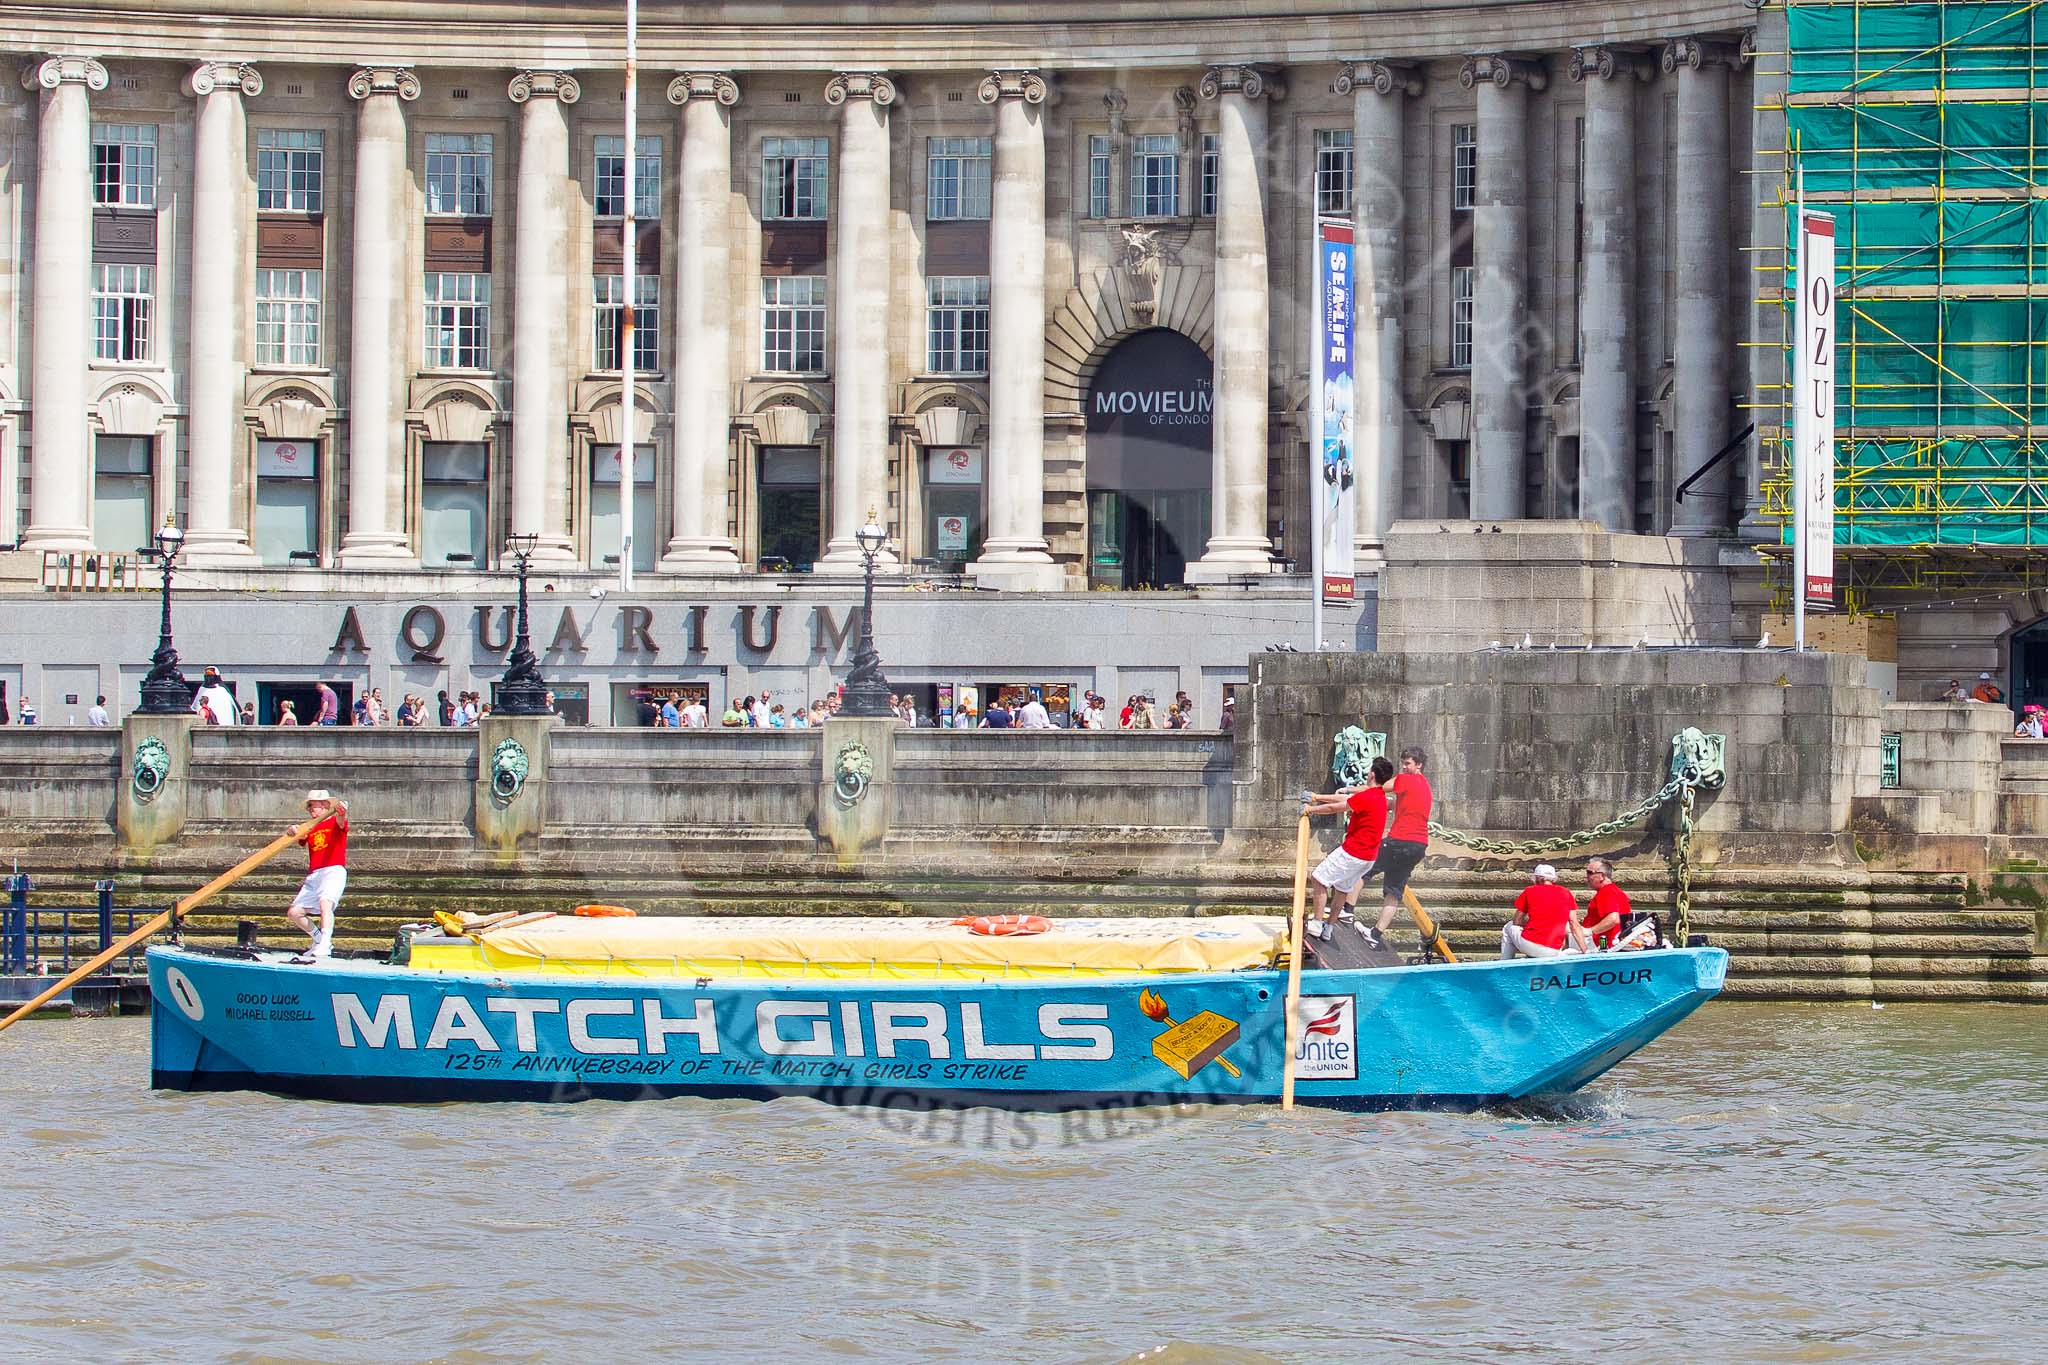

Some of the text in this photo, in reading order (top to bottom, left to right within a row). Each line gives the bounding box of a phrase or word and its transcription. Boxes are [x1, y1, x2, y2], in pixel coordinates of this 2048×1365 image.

[1812, 276, 1829, 419] OZU
[1096, 390, 1214, 414] MOVIEUM
[1149, 414, 1166, 425] OF
[329, 604, 866, 664] AQUARIUM
[175, 978, 194, 1008] 1
[1529, 968, 1653, 993] BALFOUR
[236, 992, 300, 1006] GOOD LUCK
[224, 1007, 316, 1022] MICHAEL RUSSELL
[330, 992, 1114, 1061] MATCH GIRLS
[445, 1052, 1030, 1081] 125th ANNIVERSARY OF THE MATCH GIRLS STRIKE
[1316, 1063, 1348, 1071] UNION
